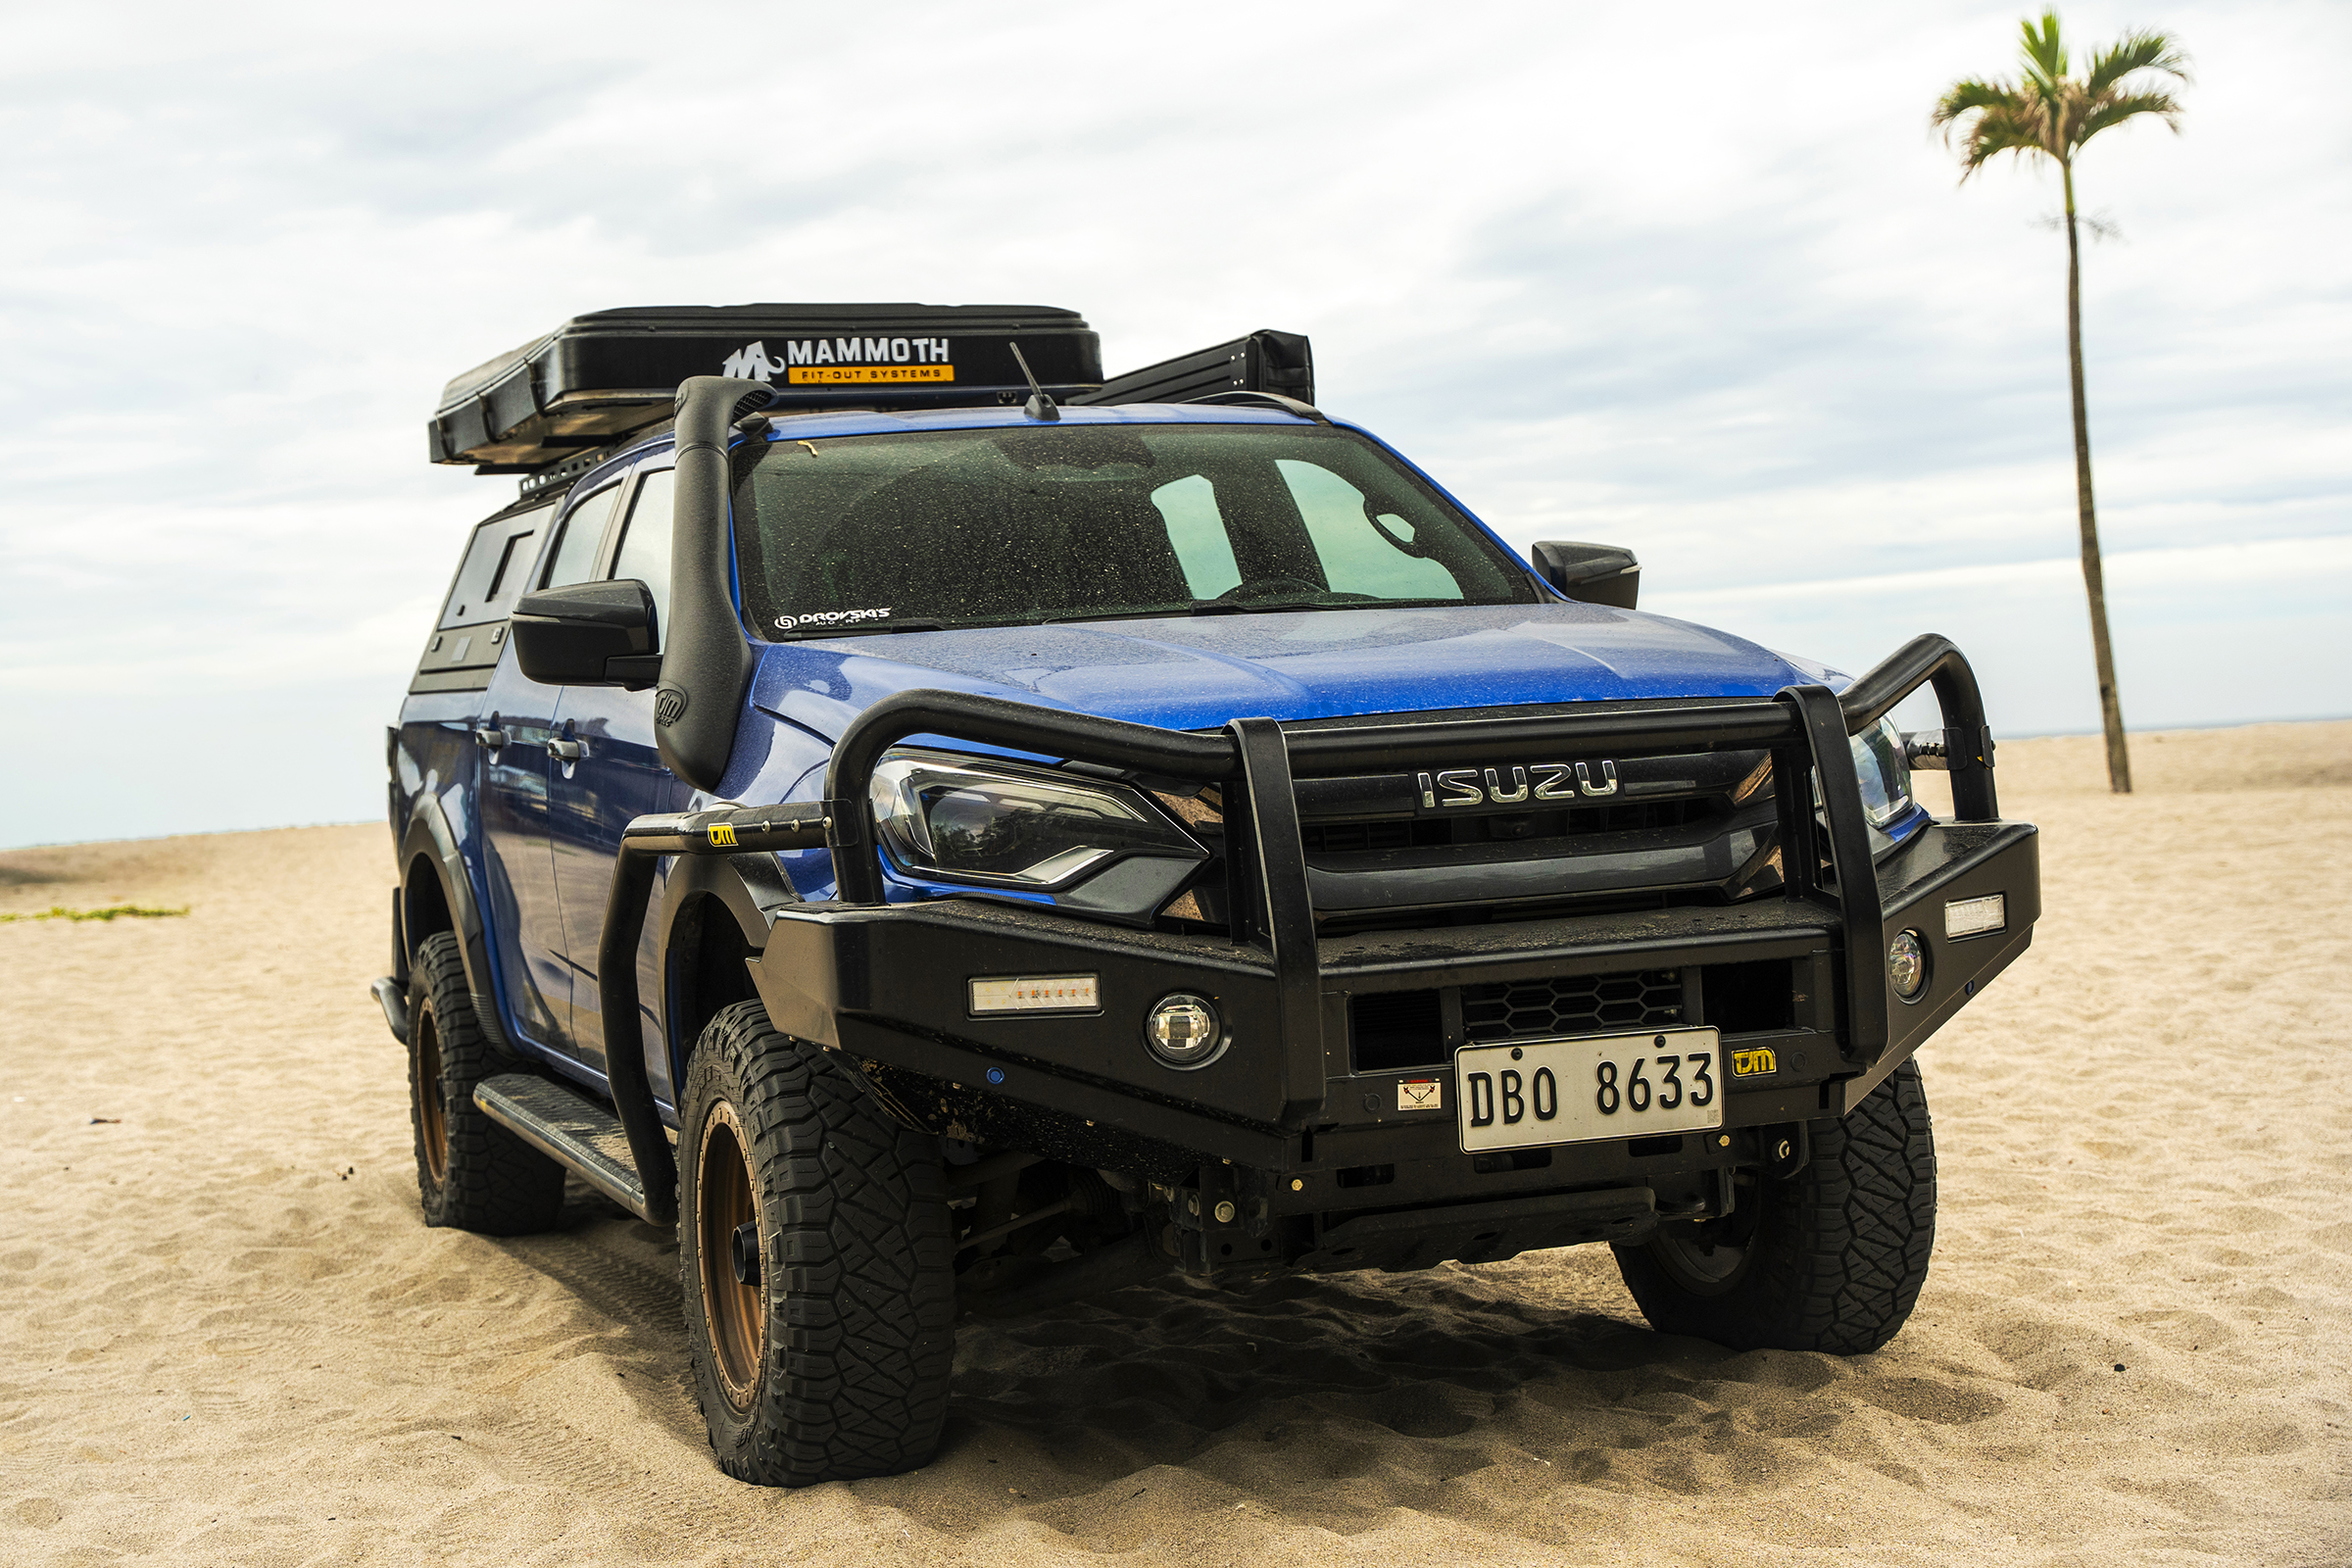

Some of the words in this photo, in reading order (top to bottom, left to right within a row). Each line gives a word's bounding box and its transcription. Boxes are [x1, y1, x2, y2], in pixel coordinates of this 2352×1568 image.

[787, 337, 949, 366] MAMMOTH
[802, 370, 862, 380] FIT-OUT
[870, 368, 942, 379] SYSTEMS
[1417, 760, 1618, 808] ISUZU
[1467, 1065, 1558, 1128] DBO
[1594, 1052, 1714, 1116] 8633
